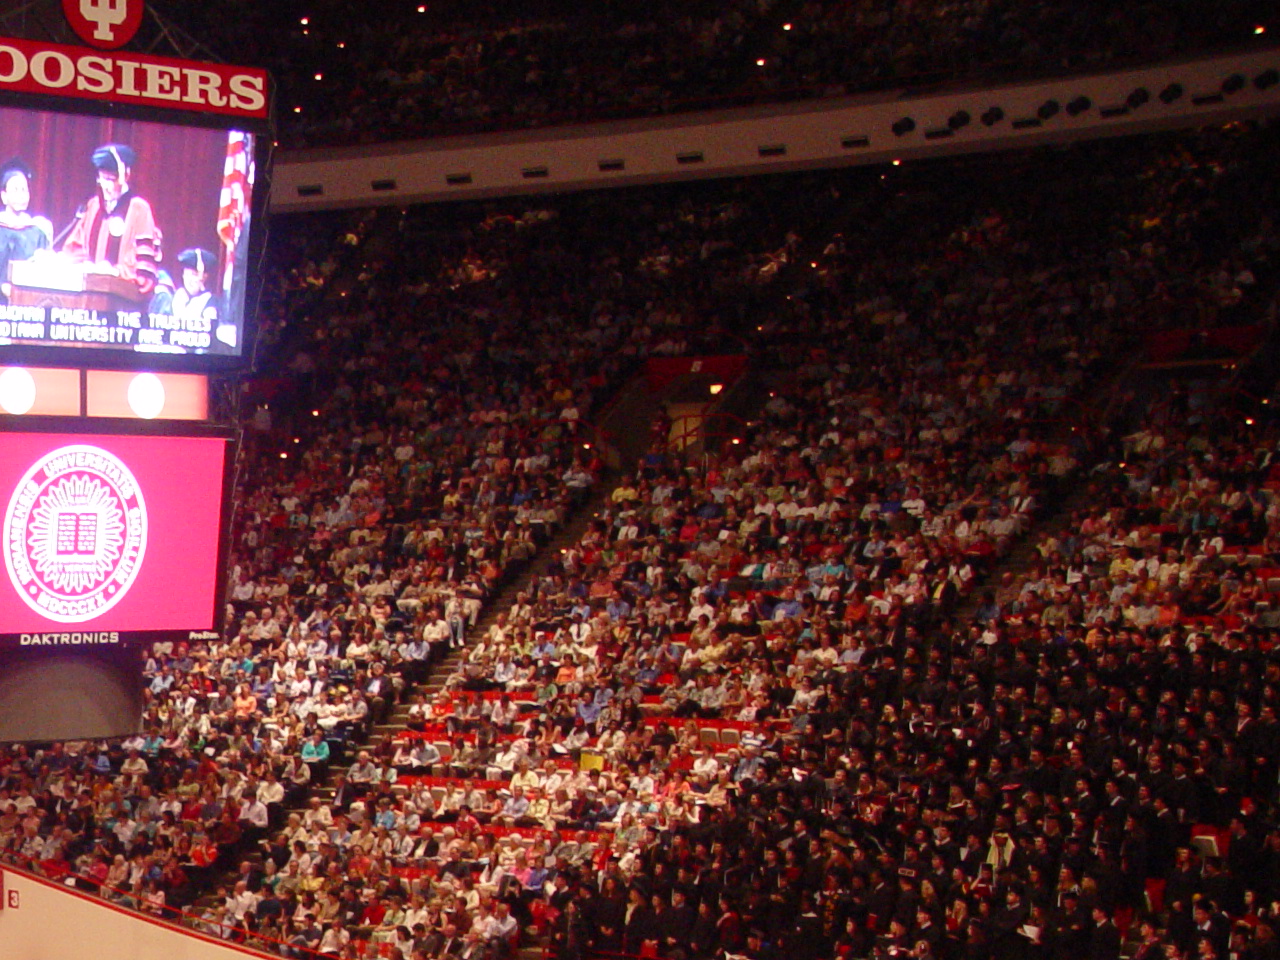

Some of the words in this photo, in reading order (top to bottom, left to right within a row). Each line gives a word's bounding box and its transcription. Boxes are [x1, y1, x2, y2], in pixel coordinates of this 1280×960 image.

[117, 311, 141, 328] THE
[149, 313, 212, 333] TRUSTEES
[50, 324, 133, 343] UNIVERSITY
[138, 329, 164, 345] ARE
[169, 332, 211, 347] PROUD
[20, 632, 119, 645] DAKTRONICS
[10, 891, 18, 907] 3
